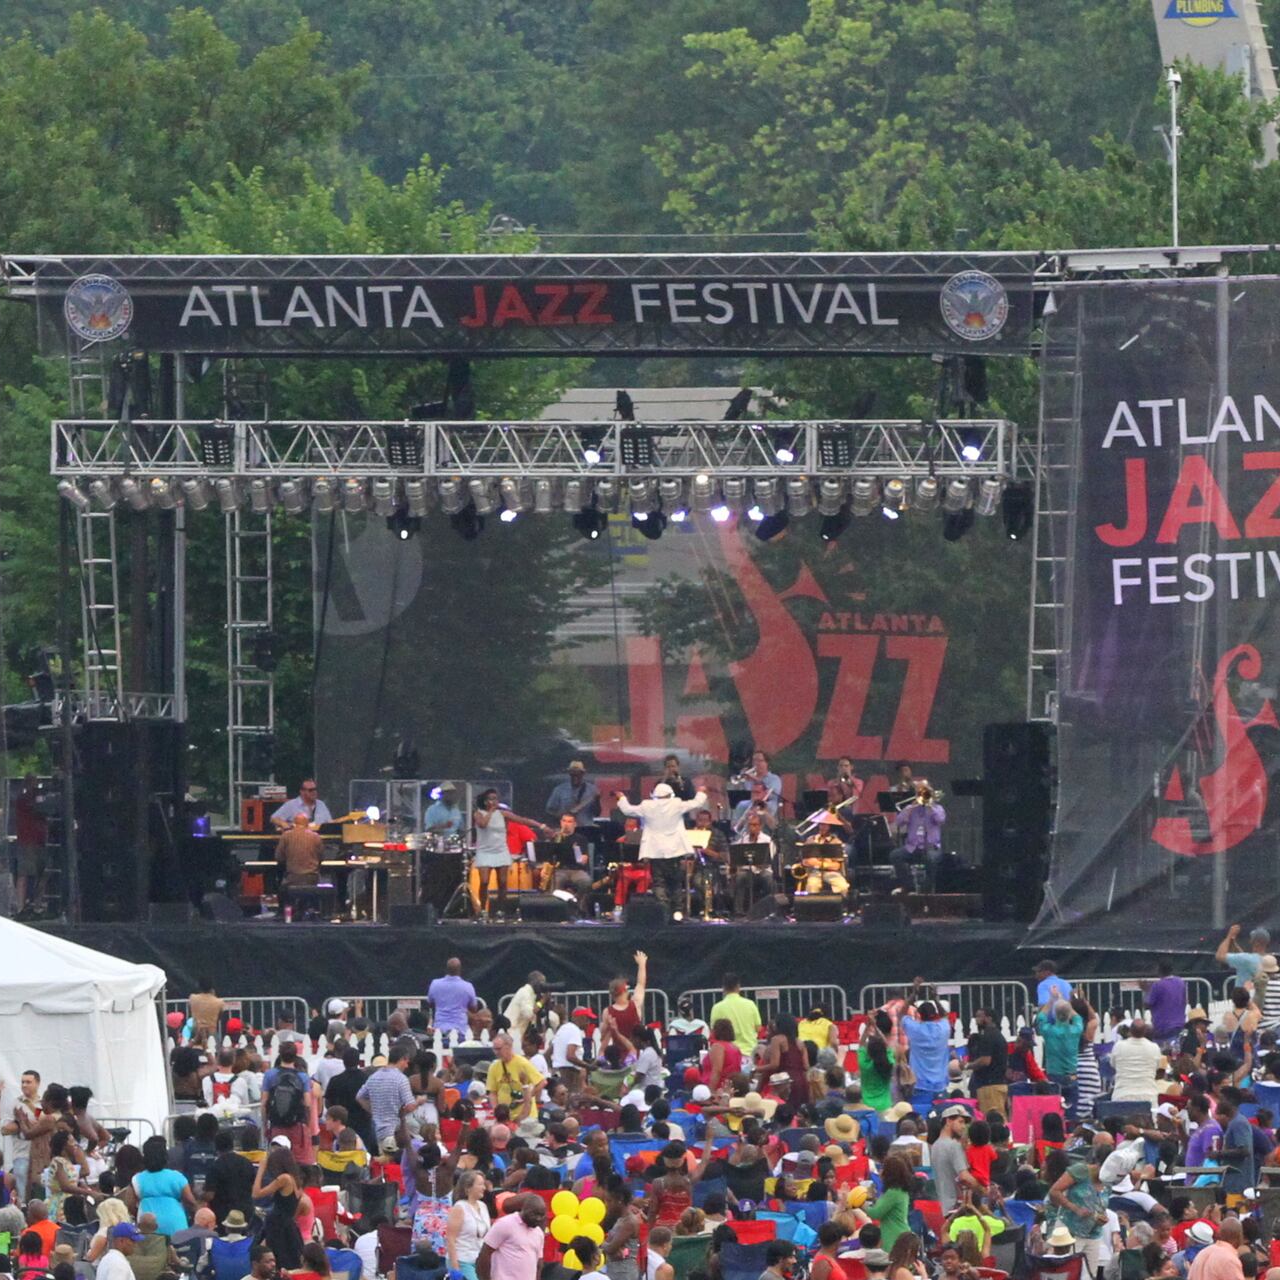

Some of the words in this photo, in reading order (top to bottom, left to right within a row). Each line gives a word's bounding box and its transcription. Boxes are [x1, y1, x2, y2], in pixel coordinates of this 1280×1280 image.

[179, 286, 444, 328] ATLANTA
[460, 283, 612, 328] JAZZ
[633, 282, 899, 326] FESTIVAL
[818, 611, 945, 633] ATLANTA
[592, 632, 951, 764] JAZZ
